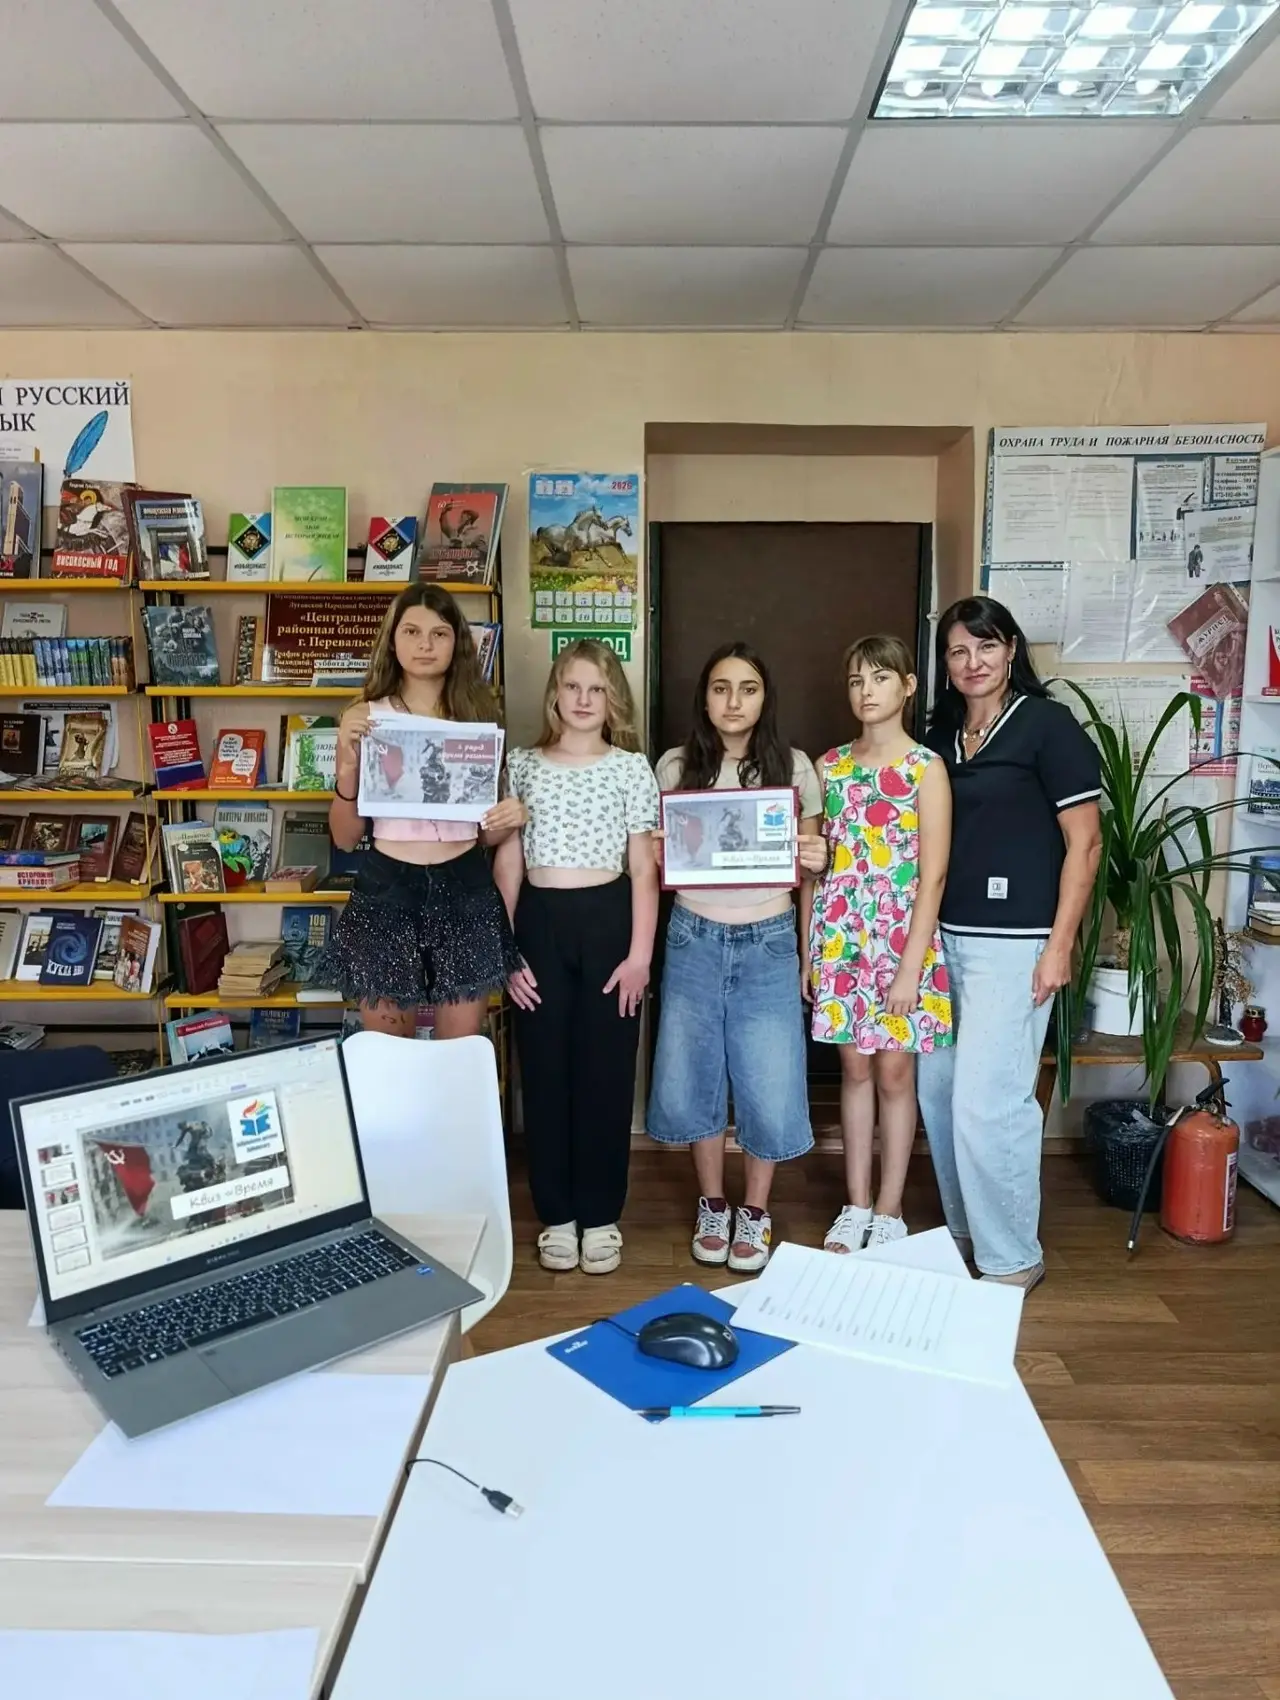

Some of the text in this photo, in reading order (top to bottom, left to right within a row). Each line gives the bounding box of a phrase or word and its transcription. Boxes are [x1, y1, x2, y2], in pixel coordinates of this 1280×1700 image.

[16, 382, 128, 405] РУССКИЙ
[1000, 434, 1265, 447] ОХРАНА ТРУДА И ПОЖАРНАЯ БЕЗОПАСНОСТЬ
[56, 555, 118, 576] ВИСОКОСНЫЙ ГОД
[277, 624, 380, 636] районная библио
[309, 914, 326, 926] 100
[190, 1193, 221, 1208] Квиз
[235, 1178, 274, 1197] Время
